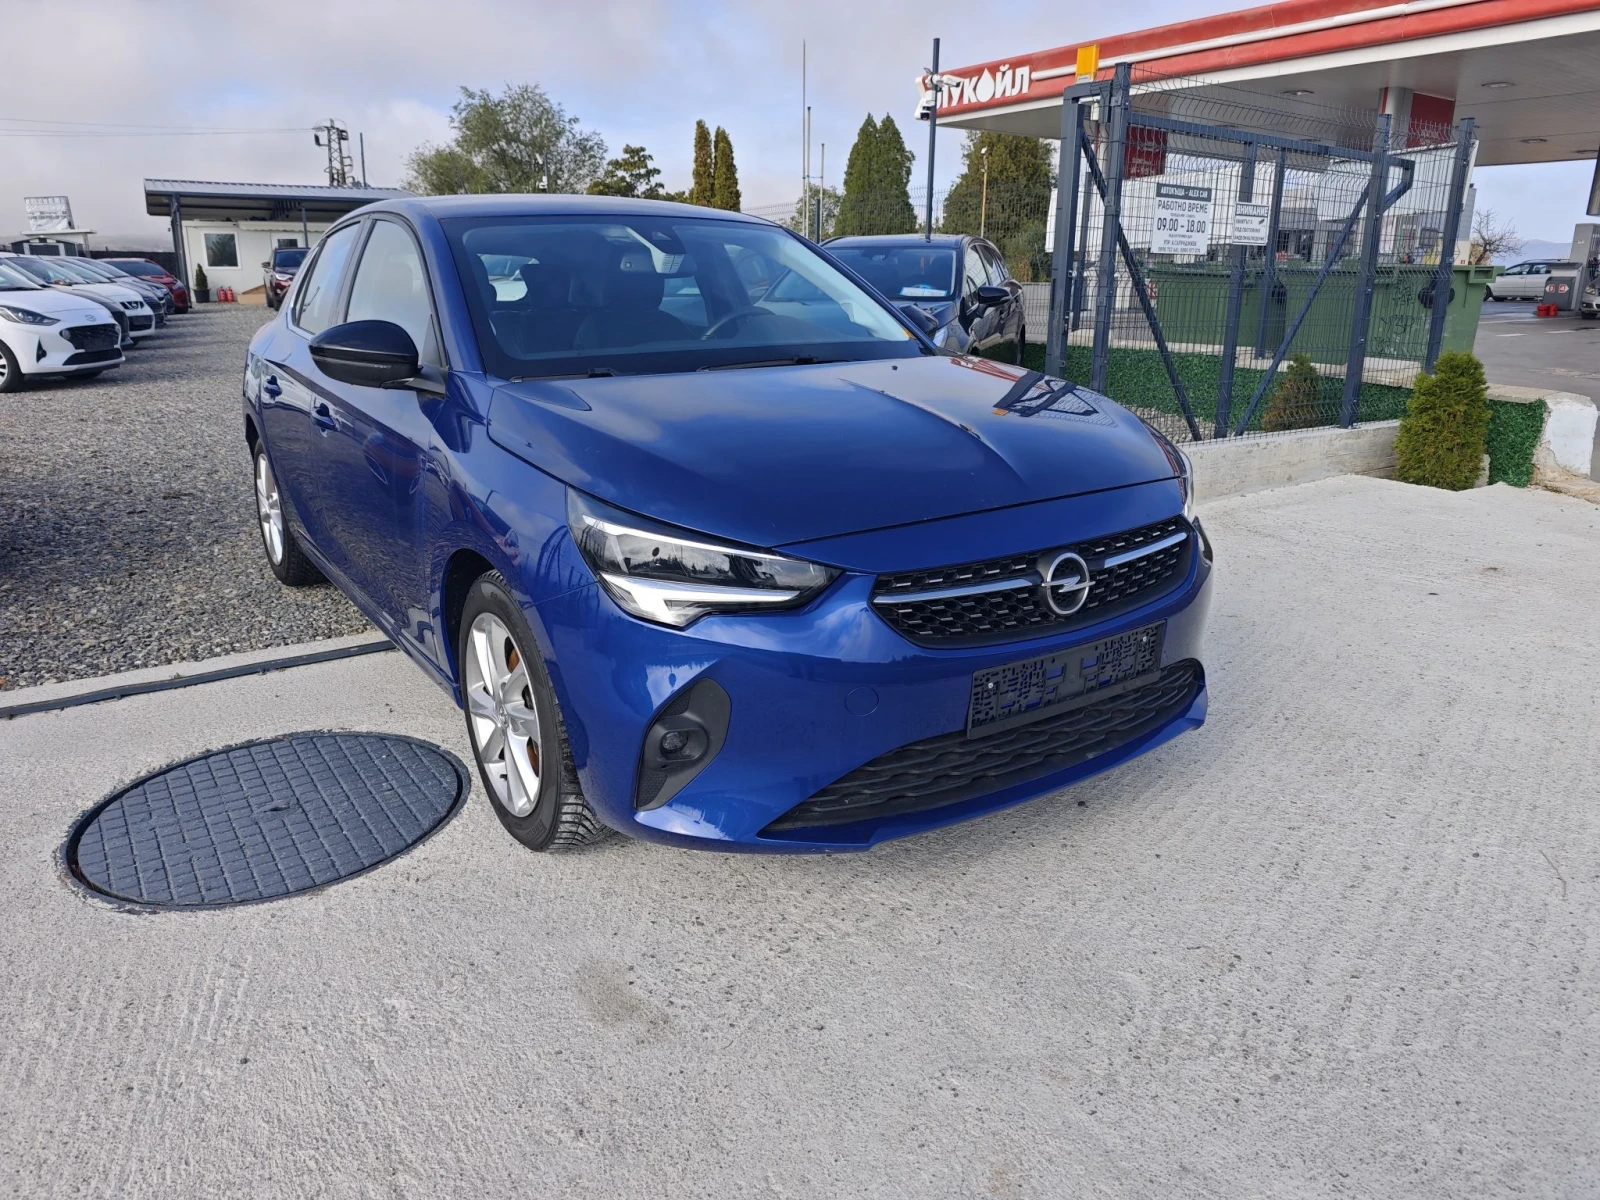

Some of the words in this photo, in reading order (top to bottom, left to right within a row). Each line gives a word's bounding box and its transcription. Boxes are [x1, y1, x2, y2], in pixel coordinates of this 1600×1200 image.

[1160, 186, 1185, 196] АВТОКЪЩА
[1189, 189, 1199, 198] ALEX
[1157, 200, 1187, 211] РАБОТНО
[1188, 202, 1208, 214] ВРЕМЕ
[1236, 204, 1269, 216] ВНИМАНИЕ
[1156, 217, 1179, 232] 09.00
[1186, 219, 1206, 234] 18.00
